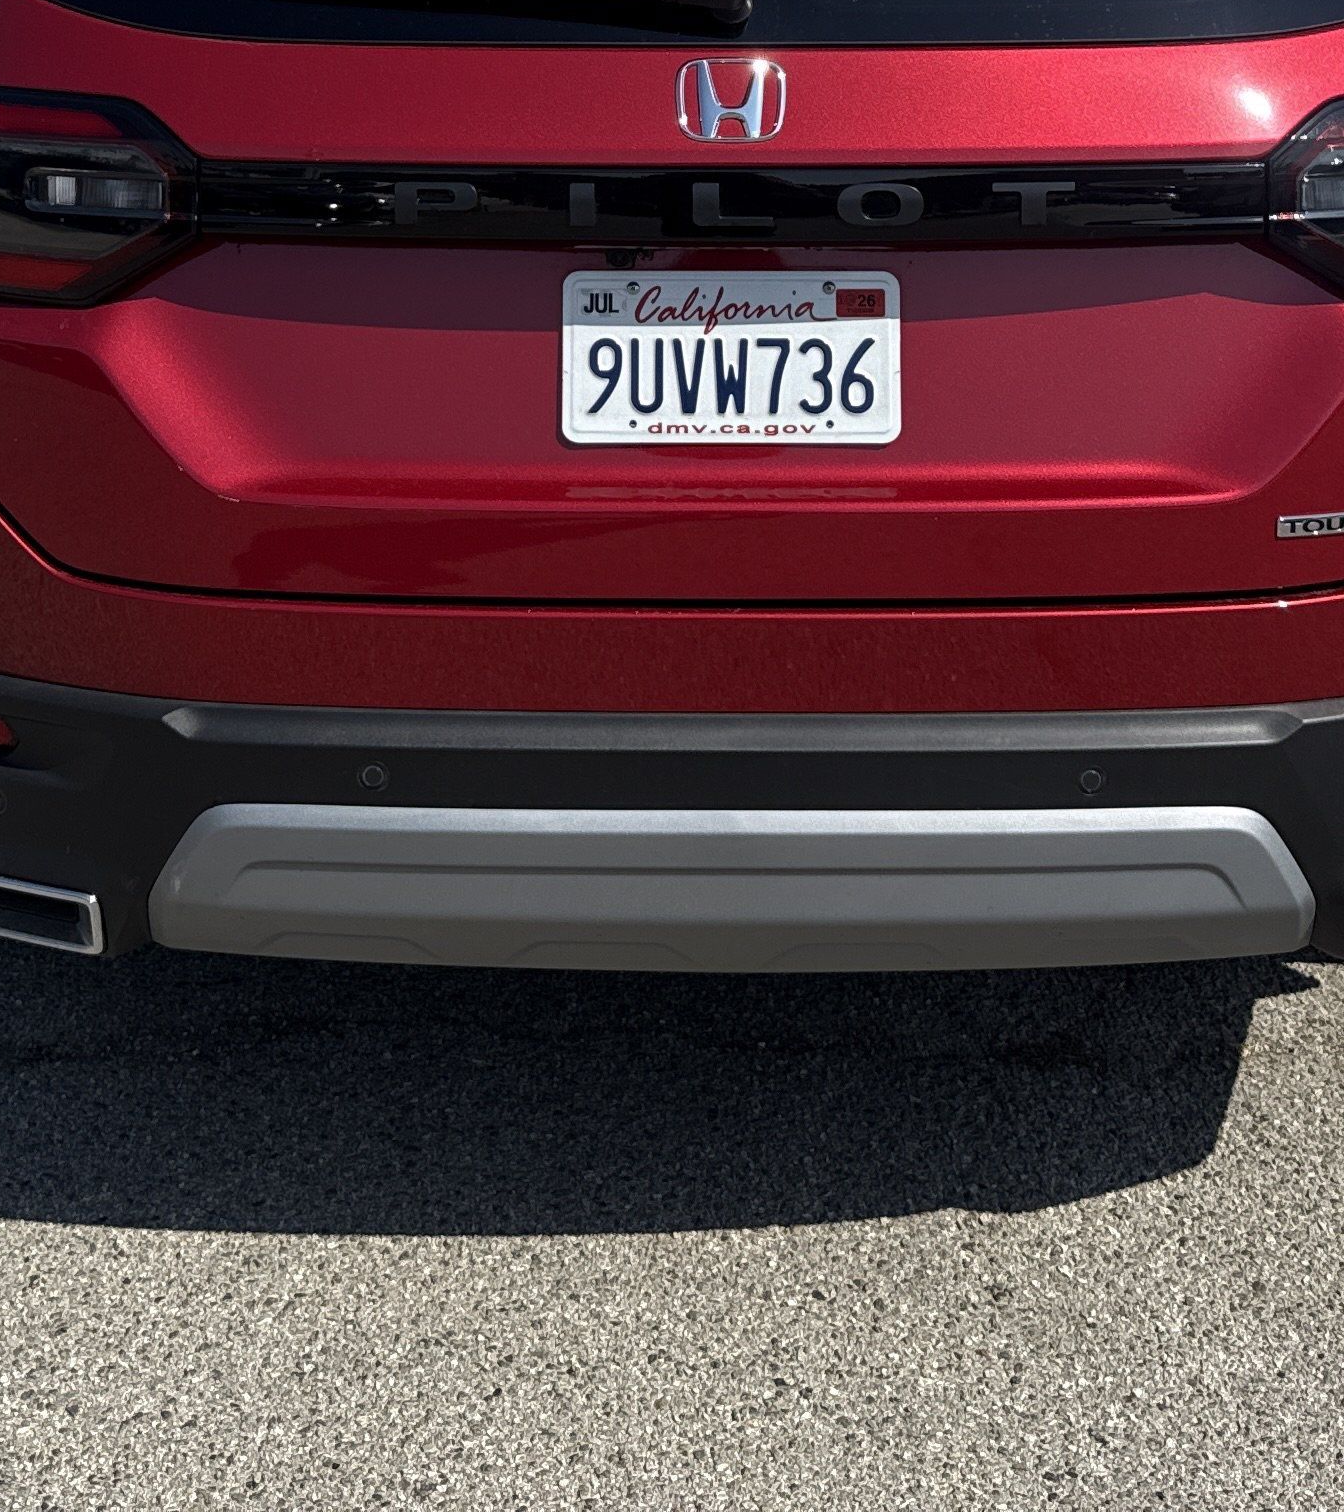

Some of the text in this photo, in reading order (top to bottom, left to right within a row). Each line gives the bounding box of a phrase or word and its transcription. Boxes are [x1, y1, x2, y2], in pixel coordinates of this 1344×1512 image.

[395, 182, 1076, 226] PILOT
[583, 293, 619, 314] JUL
[635, 286, 837, 334] California
[857, 296, 876, 308] 26
[588, 338, 875, 415] 9UVW736
[647, 422, 816, 436] dmv.ca.gov
